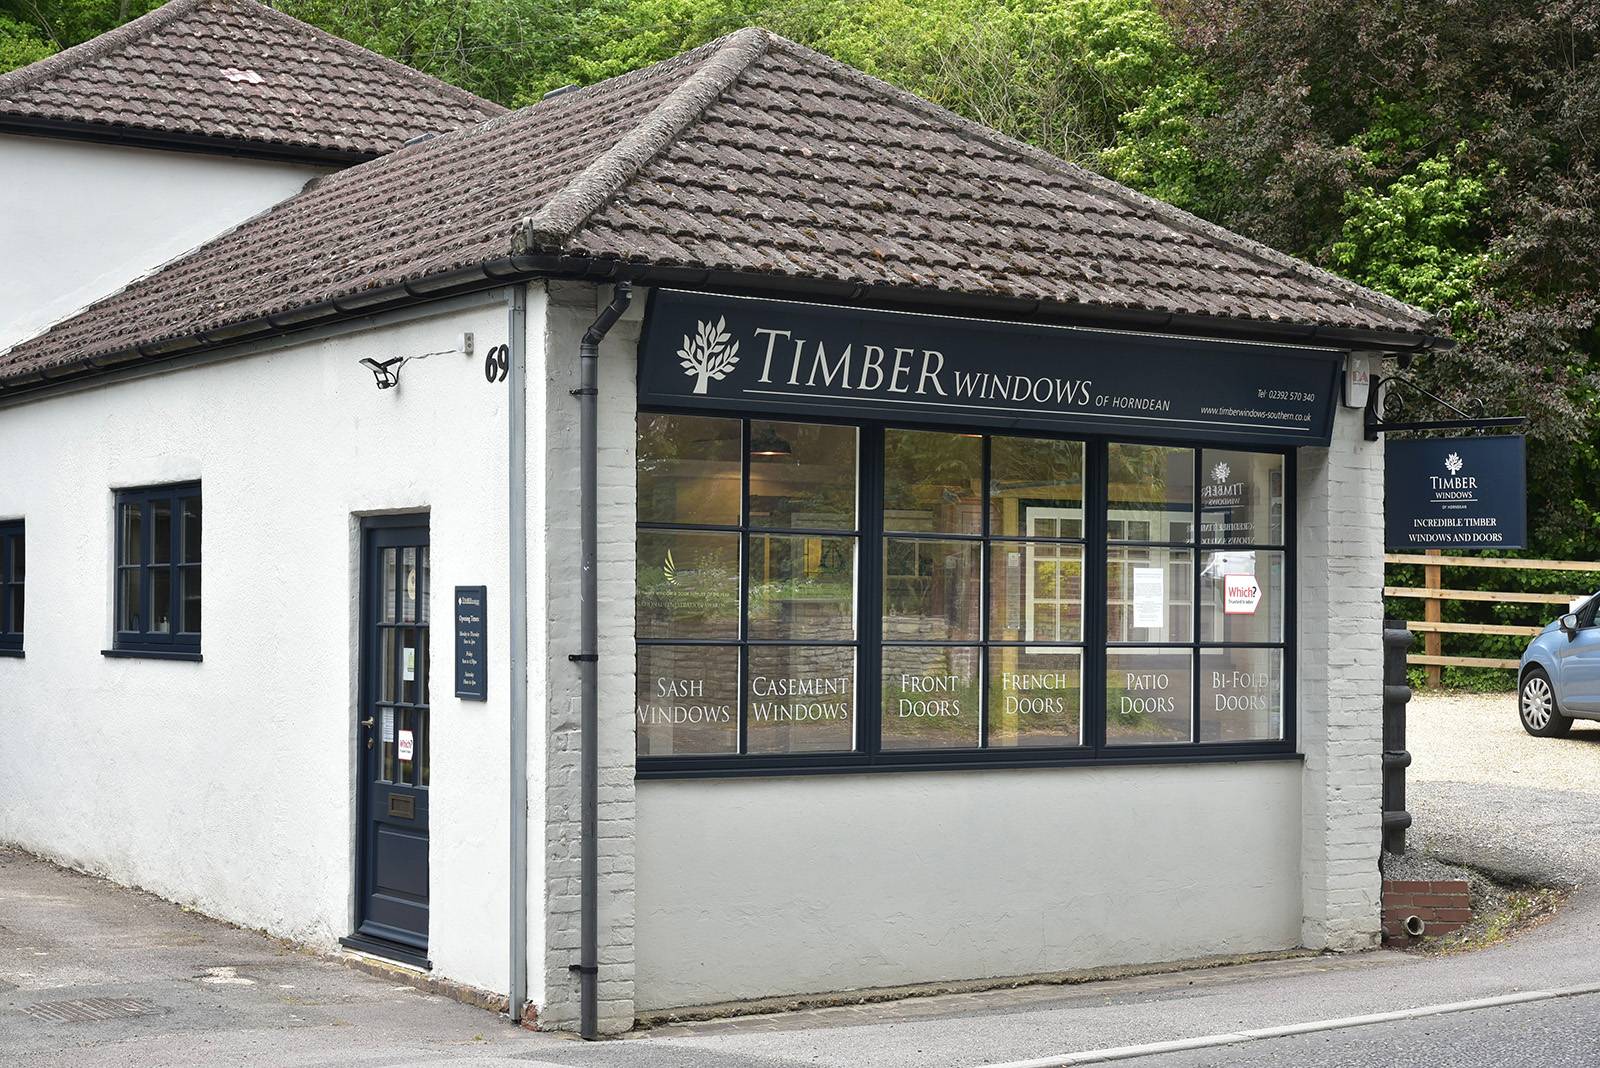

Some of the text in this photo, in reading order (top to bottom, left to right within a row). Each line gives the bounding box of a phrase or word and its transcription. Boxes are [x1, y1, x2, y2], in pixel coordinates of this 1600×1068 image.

[485, 344, 509, 383] 69
[753, 327, 1171, 412] TIMBER WINDOWS OF HORNDEAN
[1268, 390, 1288, 401] 02392
[1289, 391, 1302, 401] 570
[1303, 393, 1316, 403] 340
[1200, 406, 1312, 422] www.timberwindows-southern.co.uk
[1430, 476, 1478, 490] TIMBER
[1435, 491, 1473, 500] WINDOWS
[1414, 517, 1497, 528] INCREDIBLE TIMBER
[1408, 532, 1503, 543] WINDOWS AND DOORS
[1228, 586, 1257, 598] Which?
[656, 677, 704, 698] SASH
[752, 676, 849, 697] CASEMENT
[902, 674, 958, 692] FRONT
[1002, 672, 1066, 691] FRENCH
[1127, 673, 1169, 690] PATIO
[1212, 671, 1269, 689] BI-FOLD
[899, 699, 960, 718] DOORS
[1006, 696, 1063, 714] DOORS
[1121, 696, 1175, 714] DOORS
[1215, 694, 1266, 711] DOORS
[636, 704, 731, 724] WINDOWS
[752, 703, 849, 722] WINDOWS
